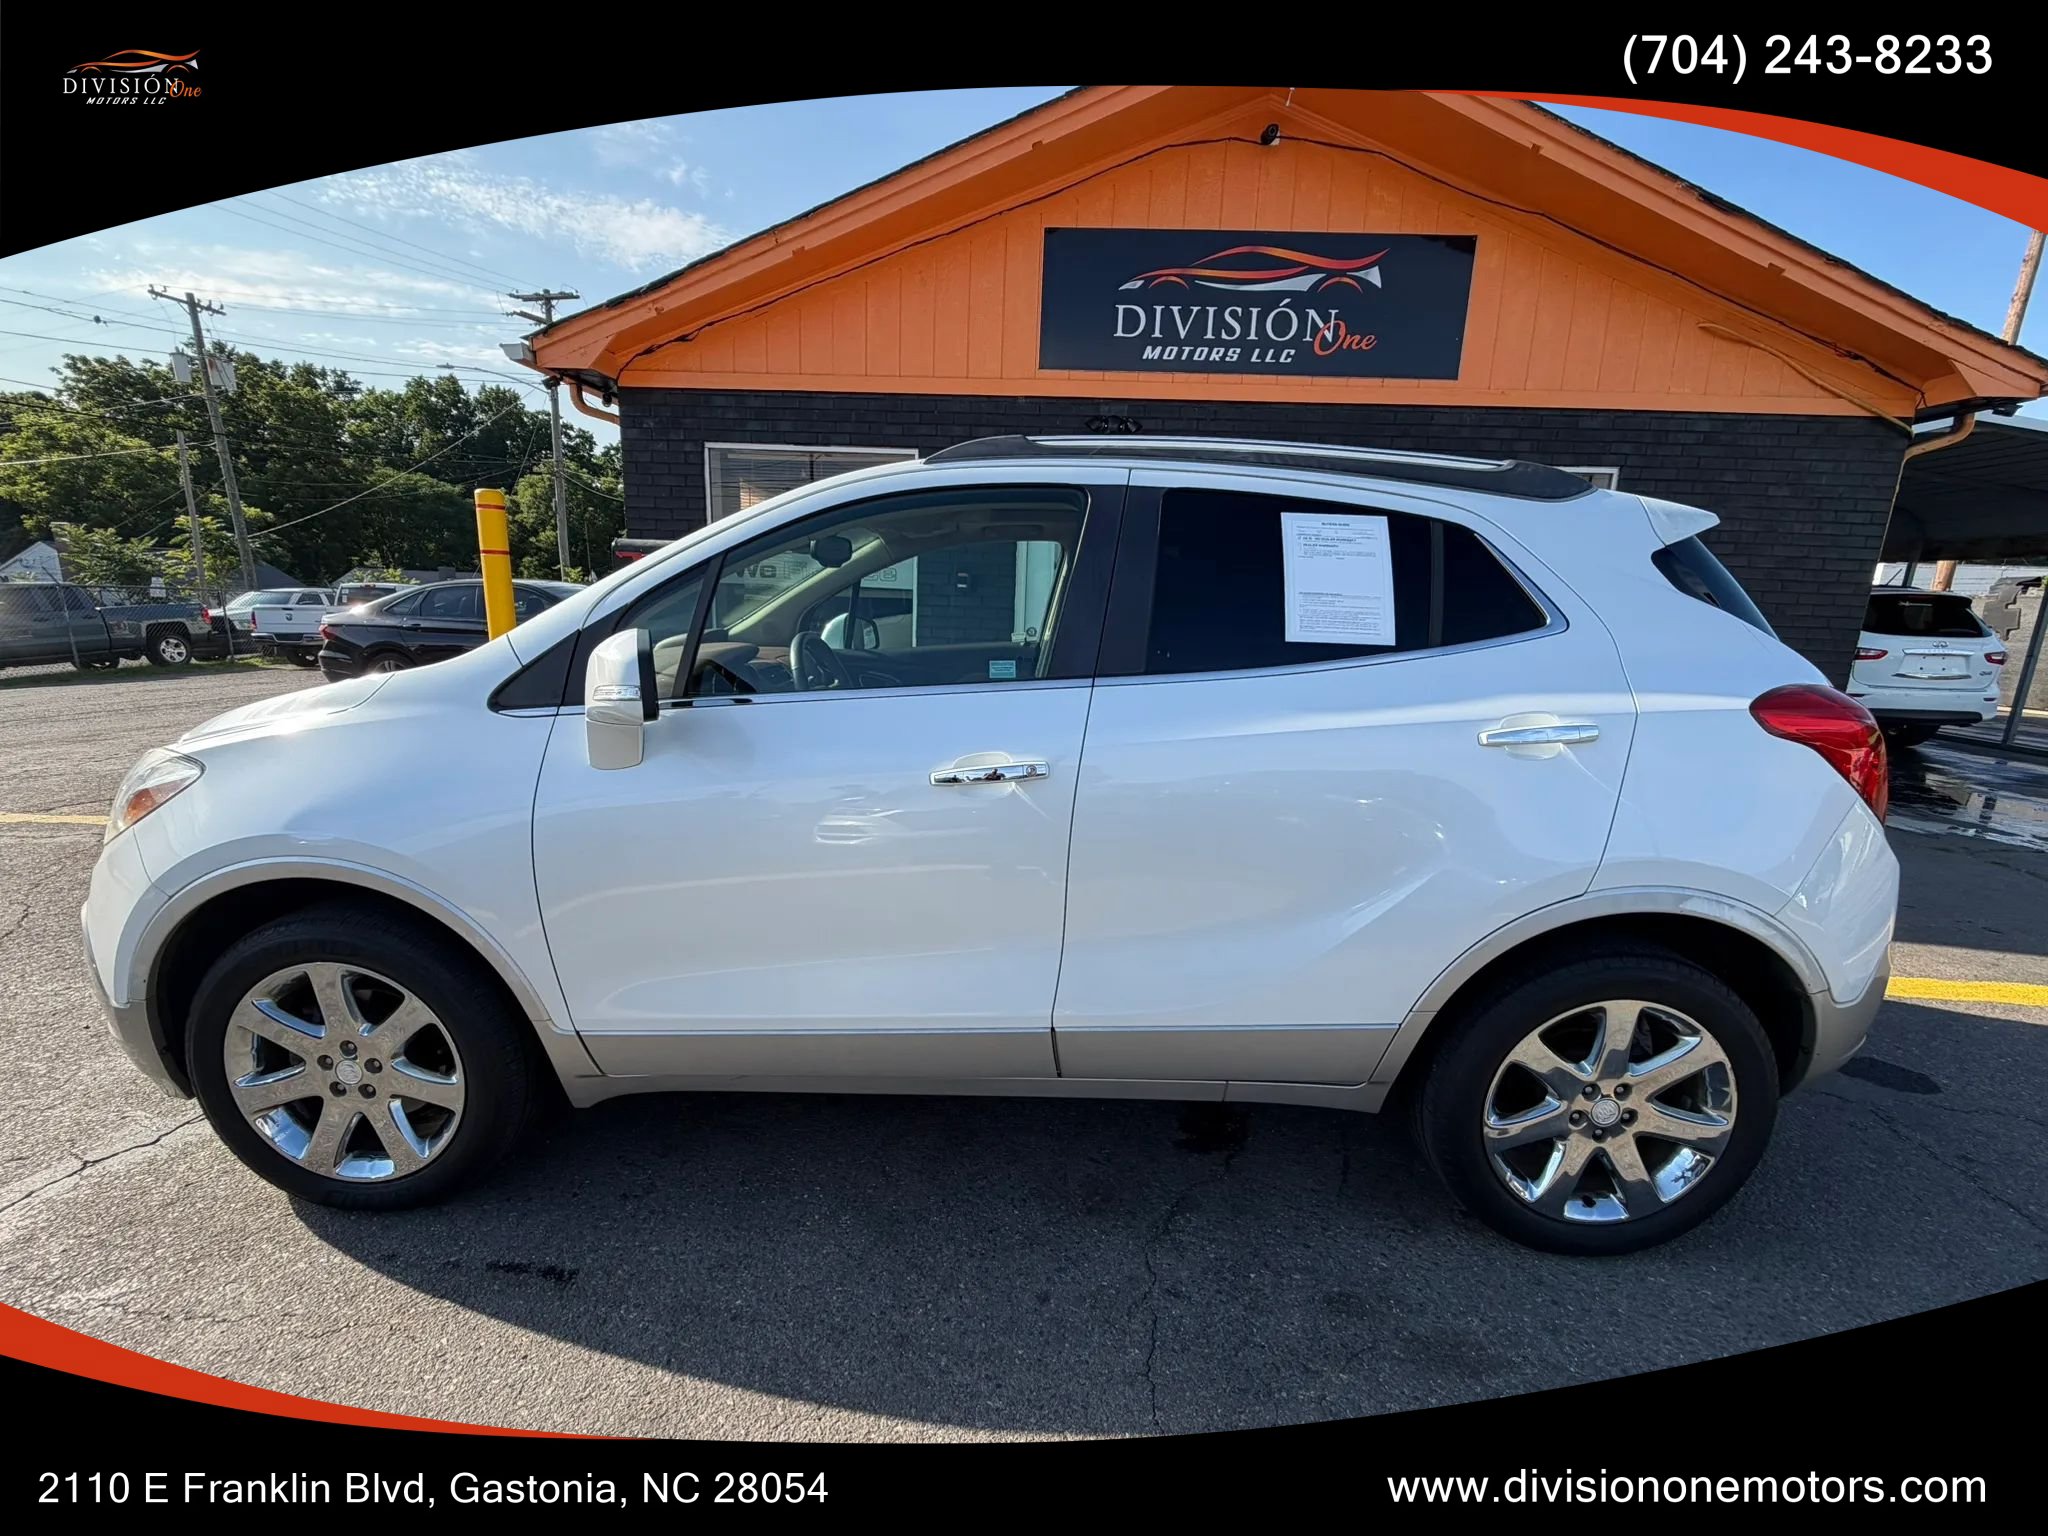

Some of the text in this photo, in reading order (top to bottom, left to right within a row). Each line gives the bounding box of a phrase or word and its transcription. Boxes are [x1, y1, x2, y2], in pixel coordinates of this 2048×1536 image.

[1113, 298, 1377, 357] DIVISIÓN One
[1142, 345, 1296, 364] MOTORS LLC
